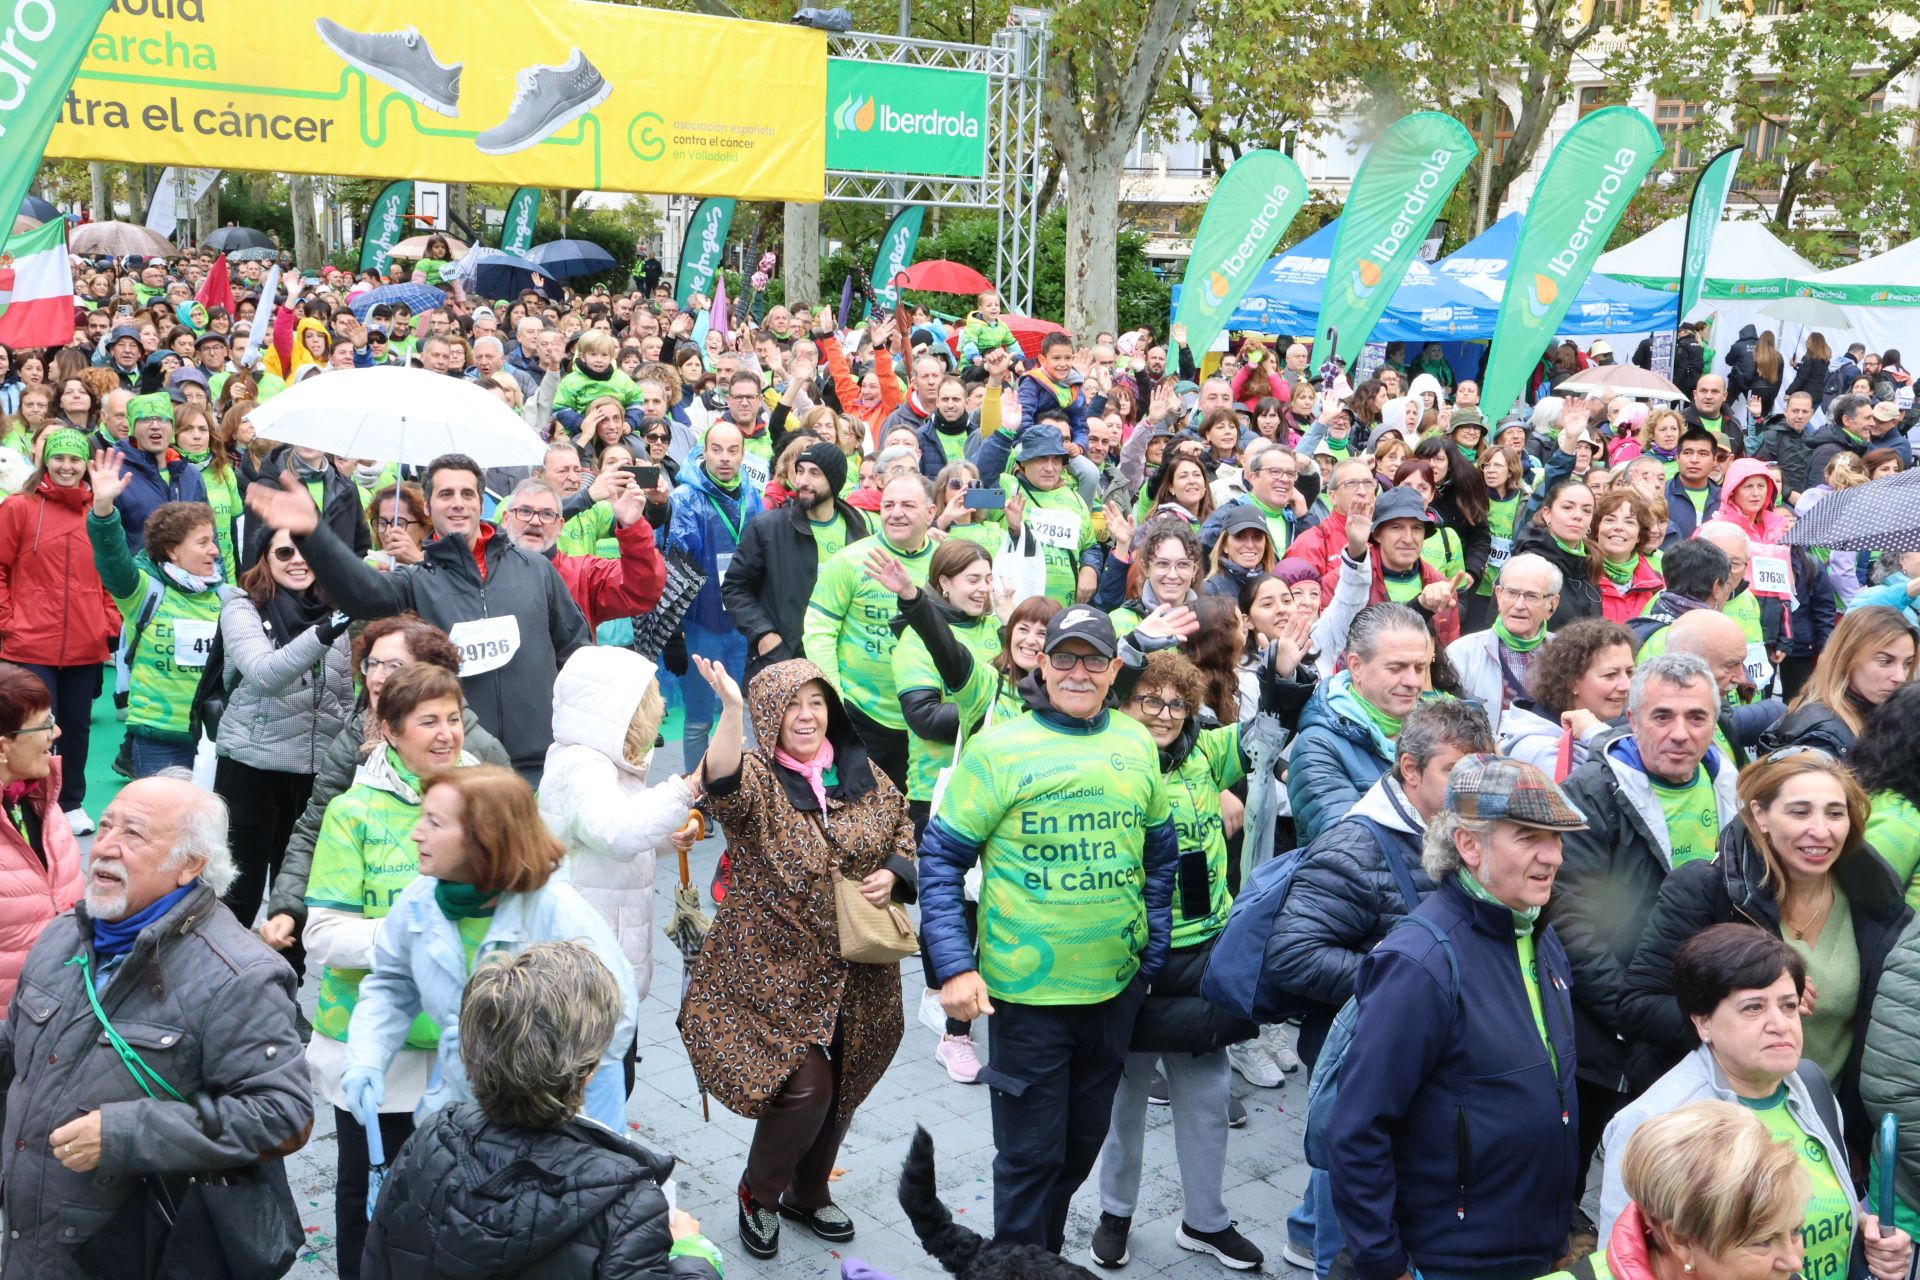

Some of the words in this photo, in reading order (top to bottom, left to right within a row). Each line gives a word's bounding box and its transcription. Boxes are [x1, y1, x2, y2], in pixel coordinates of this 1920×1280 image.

[84, 30, 217, 71] archa
[142, 96, 184, 133] el
[193, 102, 334, 143] cáncer
[880, 104, 978, 139] Iberdrola
[673, 135, 707, 146] contra
[709, 136, 718, 147] el
[720, 137, 755, 149] cáncer
[688, 150, 738, 162] Valladolid
[1370, 147, 1452, 262] Iberdrola
[1547, 147, 1637, 278] Iberdrola
[1221, 184, 1290, 279] Iberdrola
[1273, 255, 1331, 274] FM
[1744, 284, 1780, 294] Iberdrola
[1810, 288, 1847, 300] Iberdrola
[1036, 522, 1072, 540] 22834
[864, 605, 889, 619] En
[154, 644, 175, 656] co
[193, 638, 214, 653] 41
[864, 639, 883, 655] el
[155, 657, 172, 672] el
[1046, 785, 1105, 801] Valladolid
[1021, 810, 1058, 835] En
[1022, 837, 1118, 863] contra
[1023, 866, 1053, 892] el
